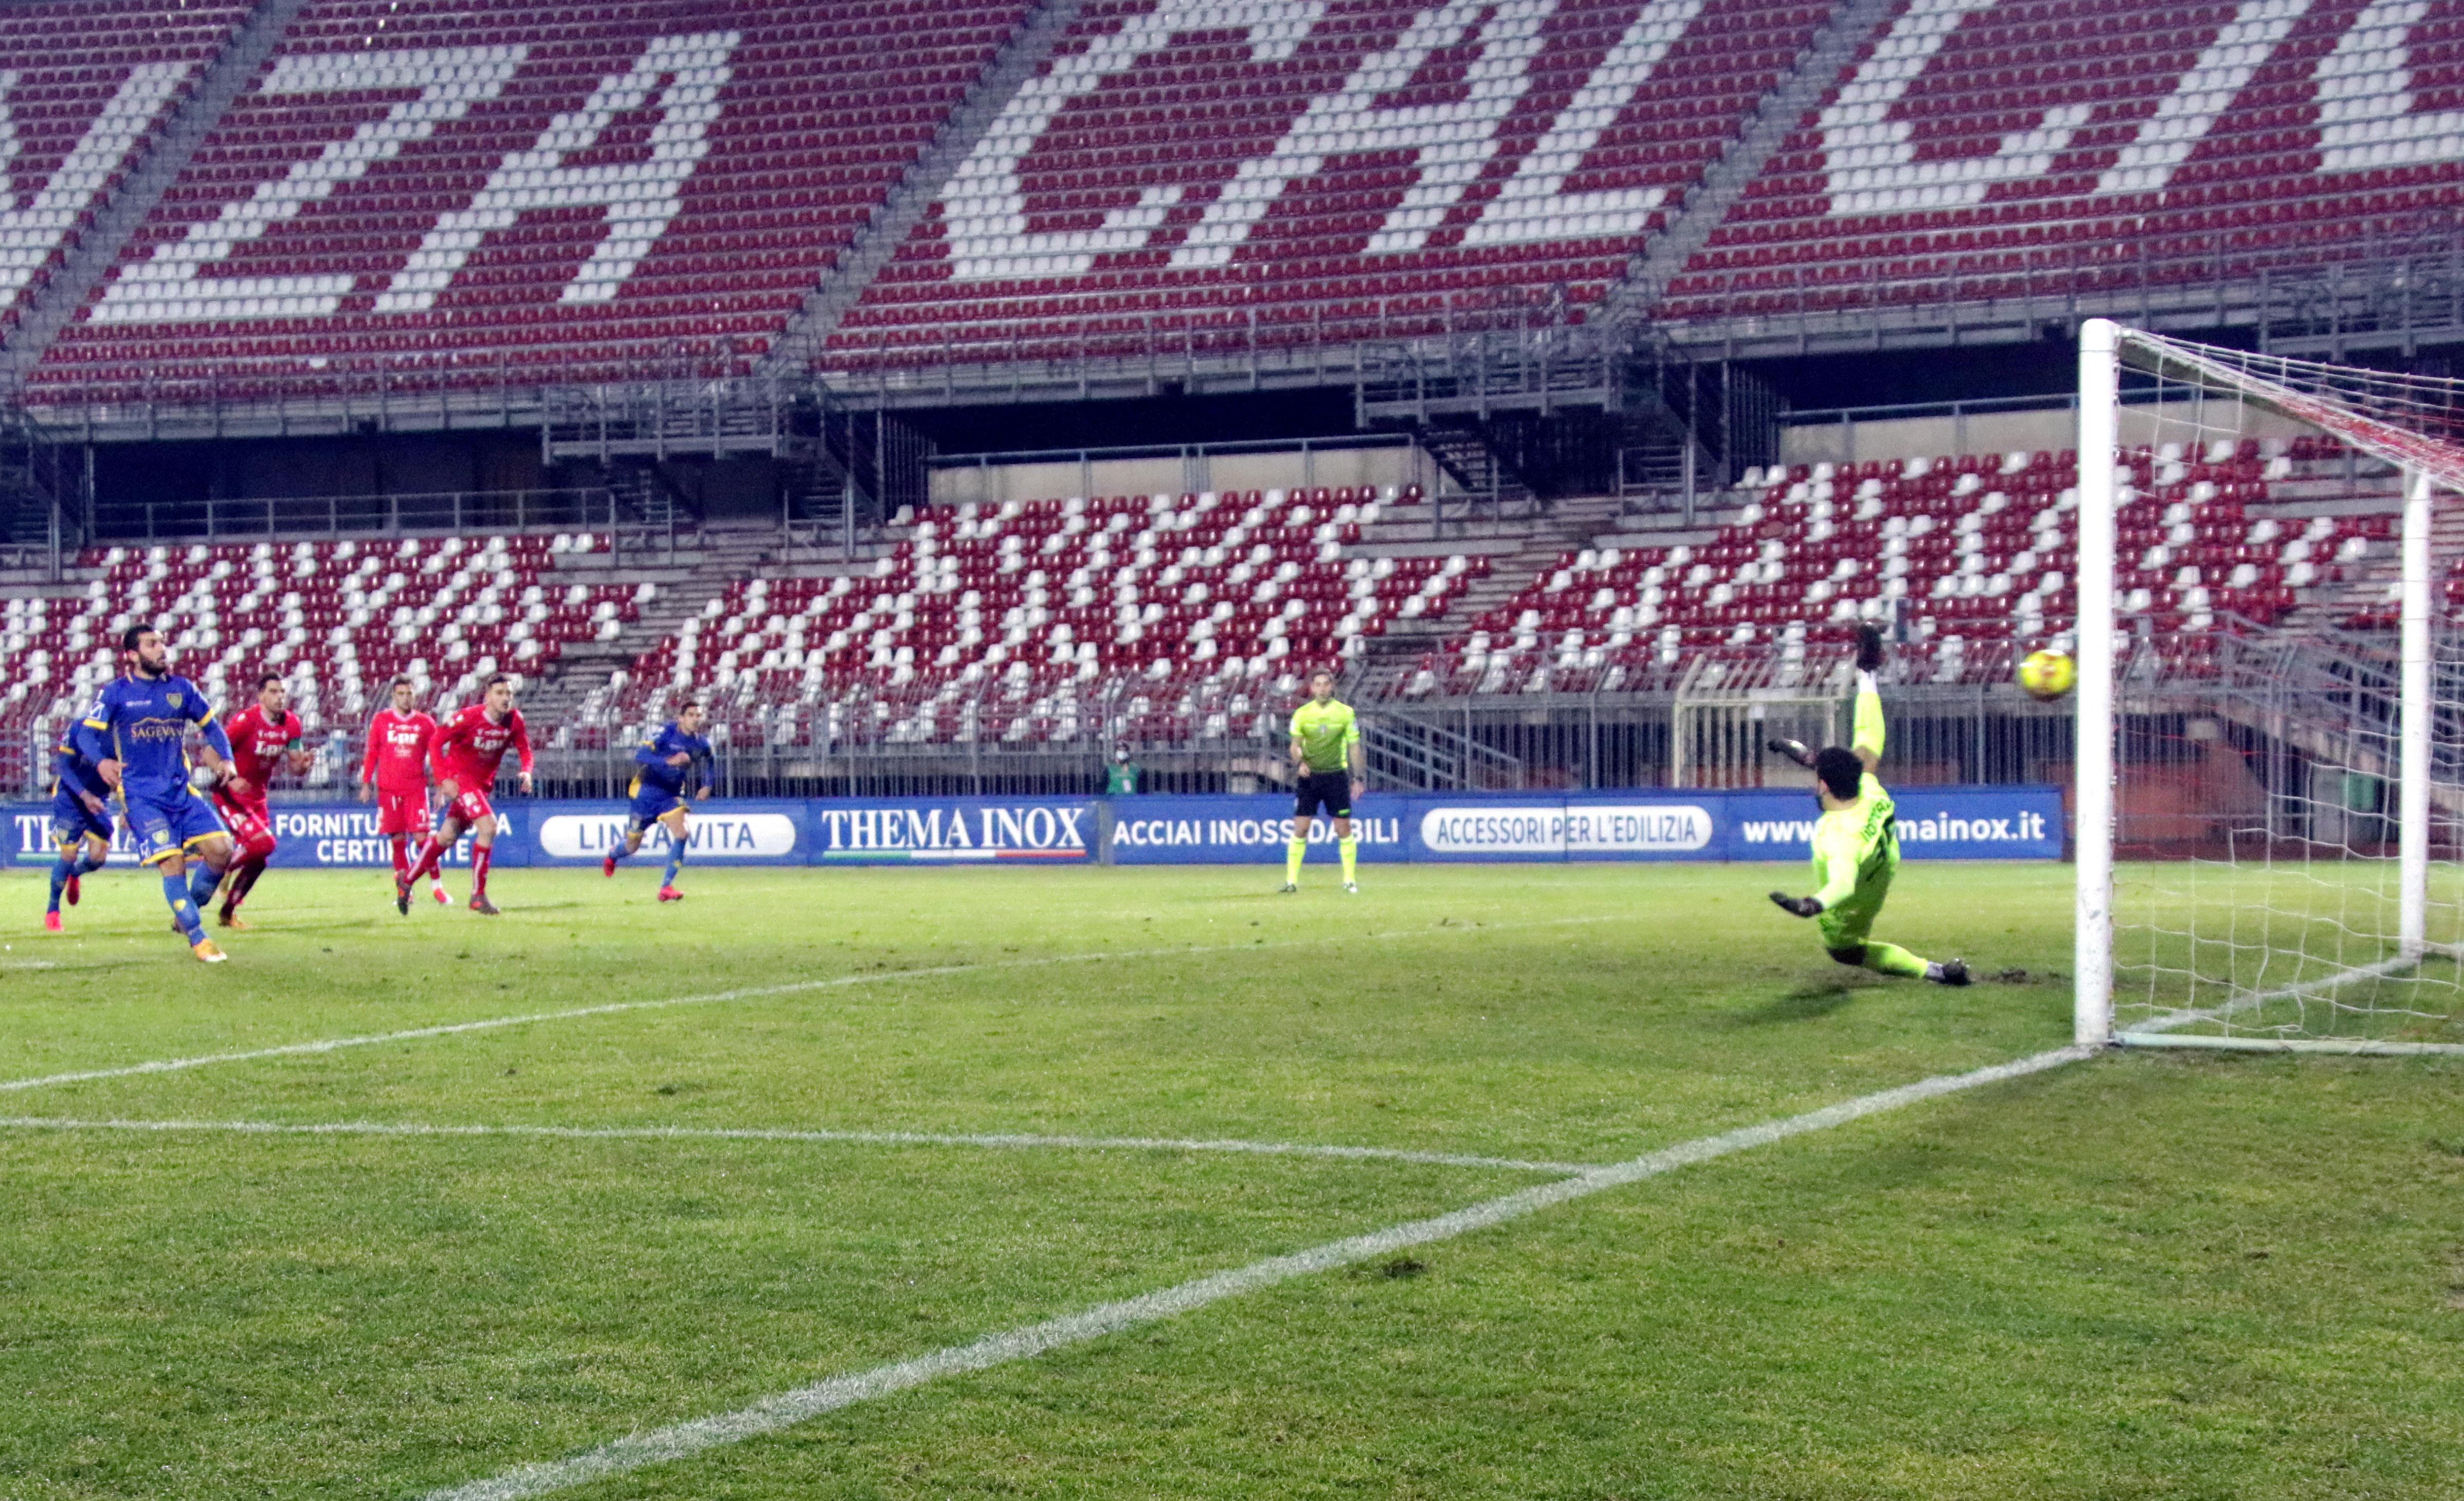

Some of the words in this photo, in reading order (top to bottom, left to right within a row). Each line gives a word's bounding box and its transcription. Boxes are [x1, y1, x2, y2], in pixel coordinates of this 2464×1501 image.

[387, 730, 419, 744] Lpr
[275, 813, 382, 837] FORNITU
[685, 821, 756, 848] VITA
[823, 809, 972, 849] THEMA
[981, 807, 1085, 848] INOX
[1113, 820, 1201, 845] ACCIAI
[1210, 817, 1399, 845] INOSSDABILI
[1438, 817, 1545, 844] ACCESSORI
[1552, 815, 1591, 843] PER
[1597, 814, 1697, 842] L'EDILIZIA
